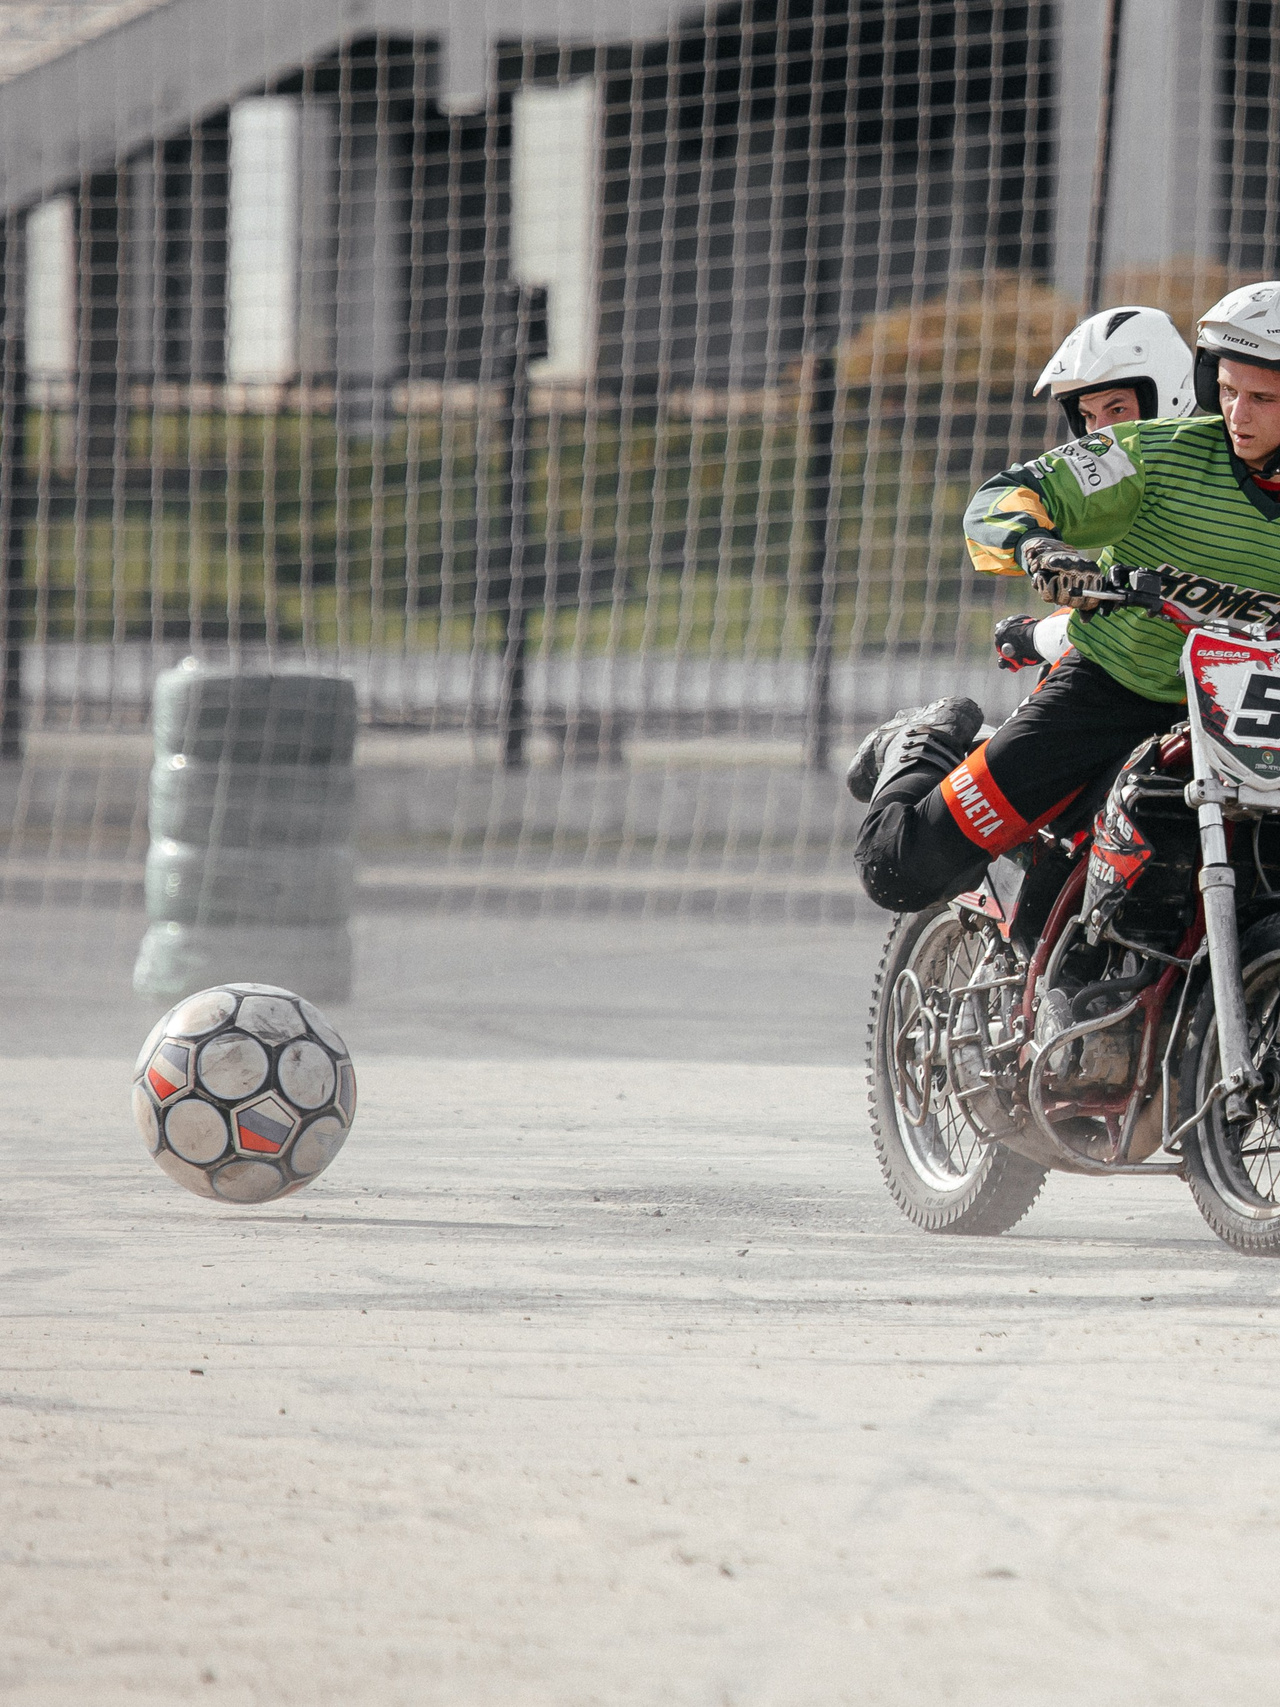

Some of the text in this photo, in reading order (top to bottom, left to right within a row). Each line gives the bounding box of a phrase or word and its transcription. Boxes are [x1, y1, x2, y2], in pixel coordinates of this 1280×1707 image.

[1222, 333, 1260, 349] hebo
[1197, 649, 1251, 659] GASGAS
[948, 763, 1005, 838] КОМЕТА
